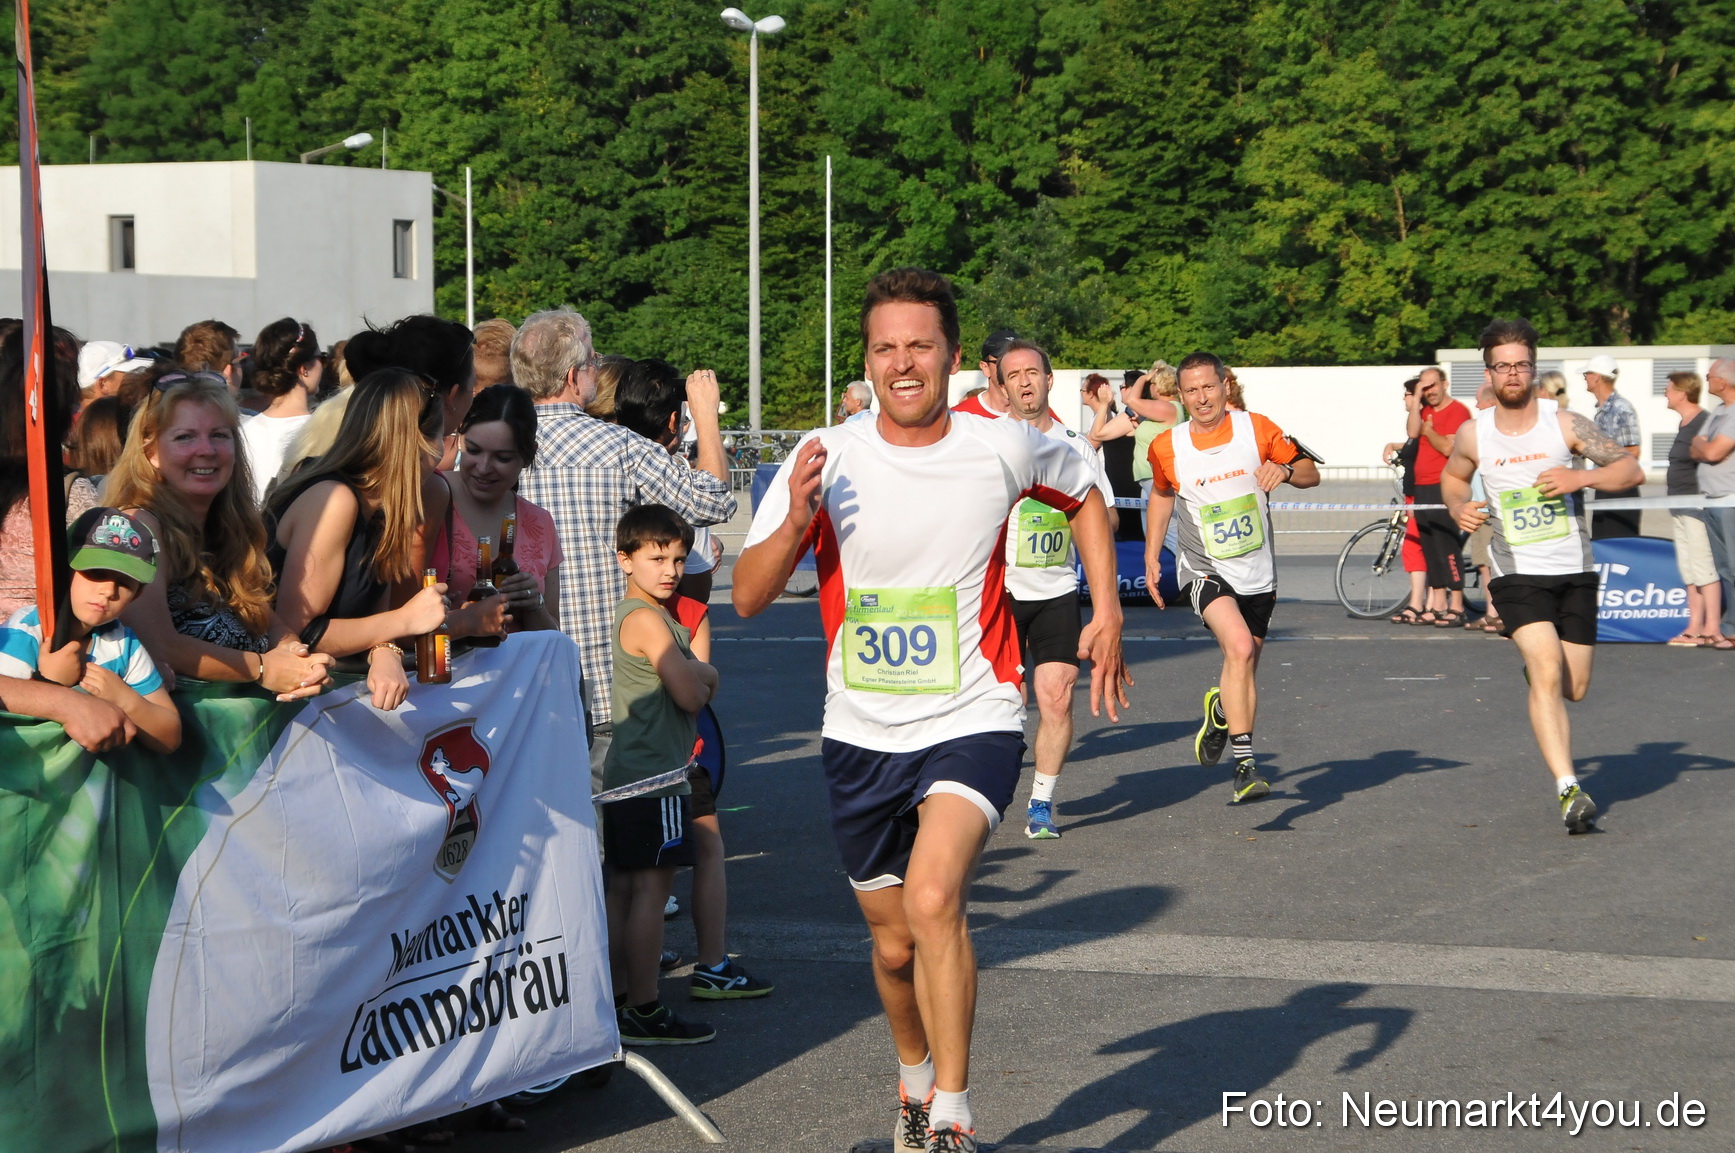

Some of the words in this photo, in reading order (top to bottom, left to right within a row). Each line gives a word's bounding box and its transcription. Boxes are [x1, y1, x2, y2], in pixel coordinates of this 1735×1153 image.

[1509, 452, 1550, 464] KLEBL
[1209, 469, 1248, 483] KLEBL
[1213, 515, 1254, 544] 543
[1513, 503, 1556, 530] 539
[1027, 530, 1064, 554] 100
[855, 624, 937, 667] 309
[877, 668, 904, 676] Christian
[878, 677, 916, 685] Pflastersteine
[443, 839, 468, 867] 1628
[385, 890, 528, 982] Neumarkter
[340, 941, 569, 1074] Lammsbräu
